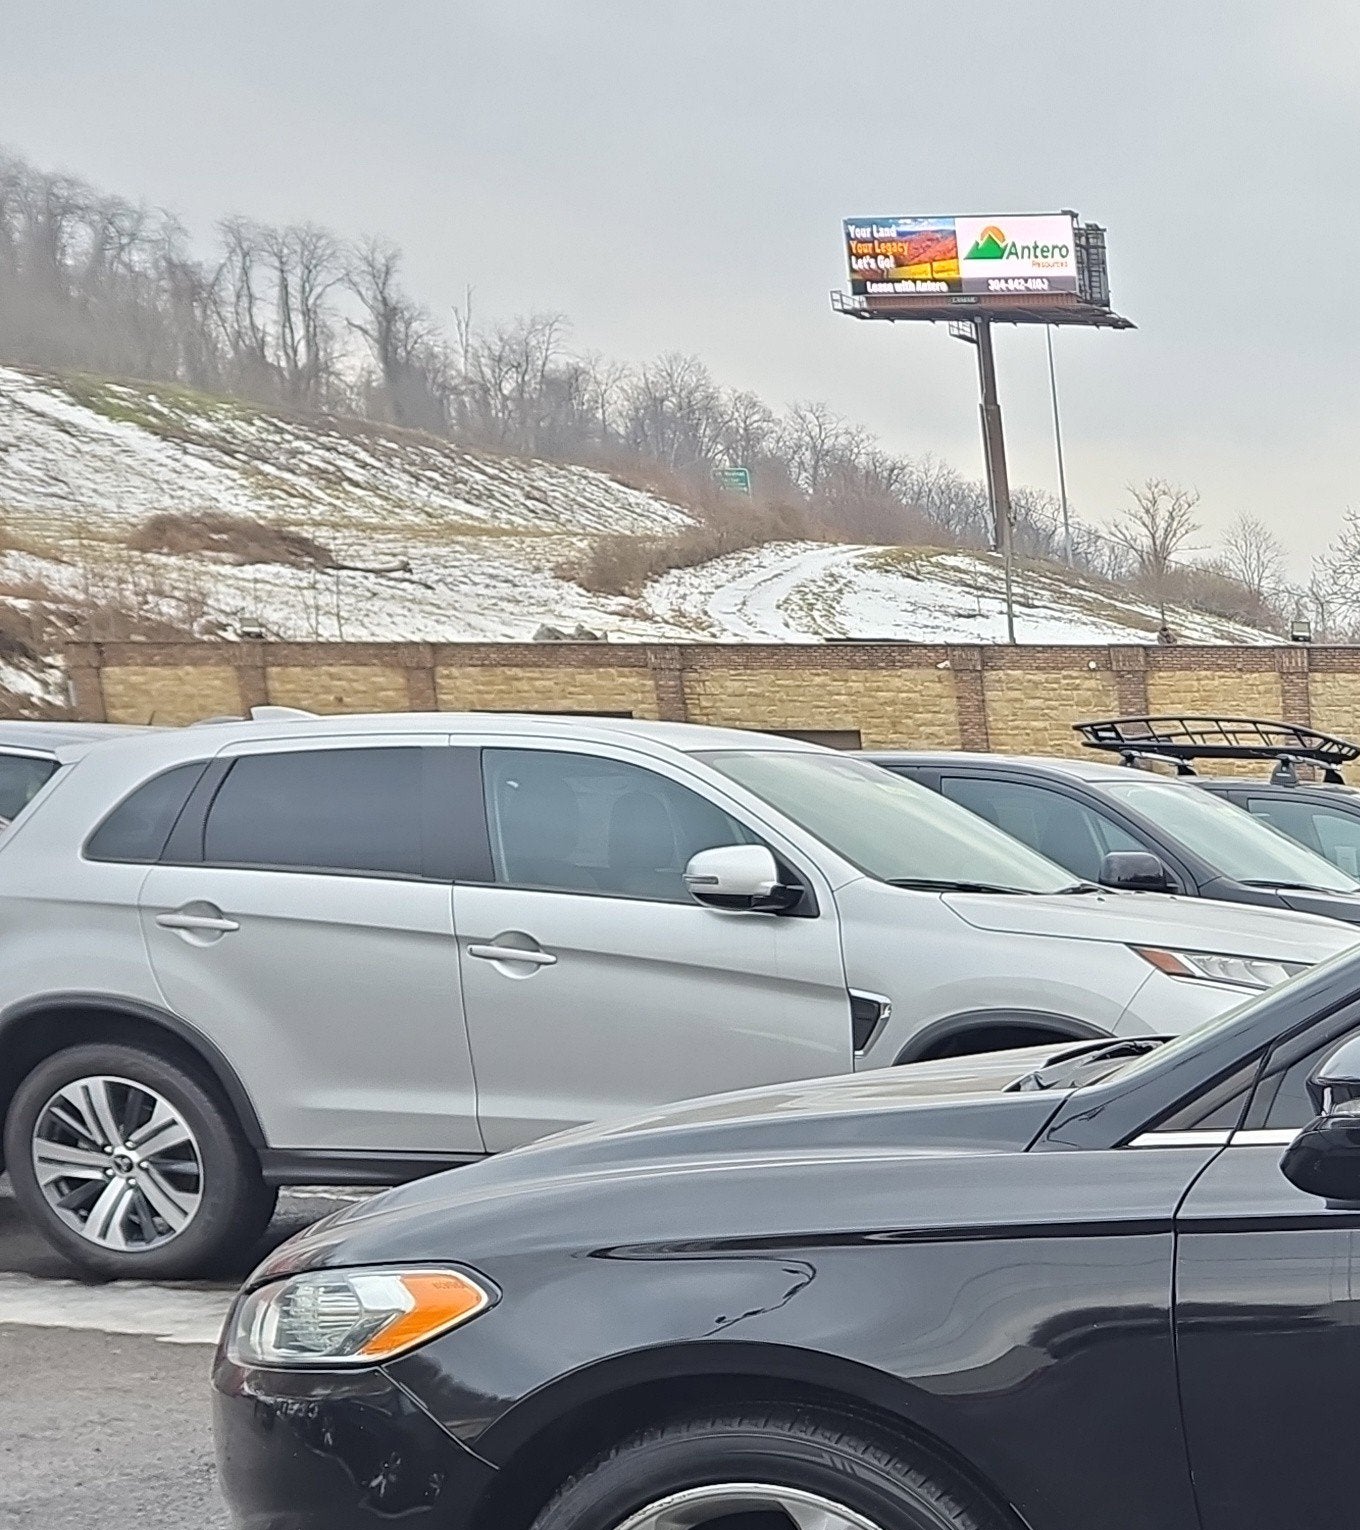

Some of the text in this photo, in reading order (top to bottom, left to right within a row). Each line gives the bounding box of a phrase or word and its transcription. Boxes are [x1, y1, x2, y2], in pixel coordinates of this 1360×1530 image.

[848, 224, 897, 239] Your Land
[849, 239, 909, 255] Your Legacy
[1005, 240, 1070, 260] Antero
[851, 255, 876, 270] Let's
[1031, 260, 1069, 269] Resources
[893, 280, 915, 293] with
[915, 280, 949, 293] Antero
